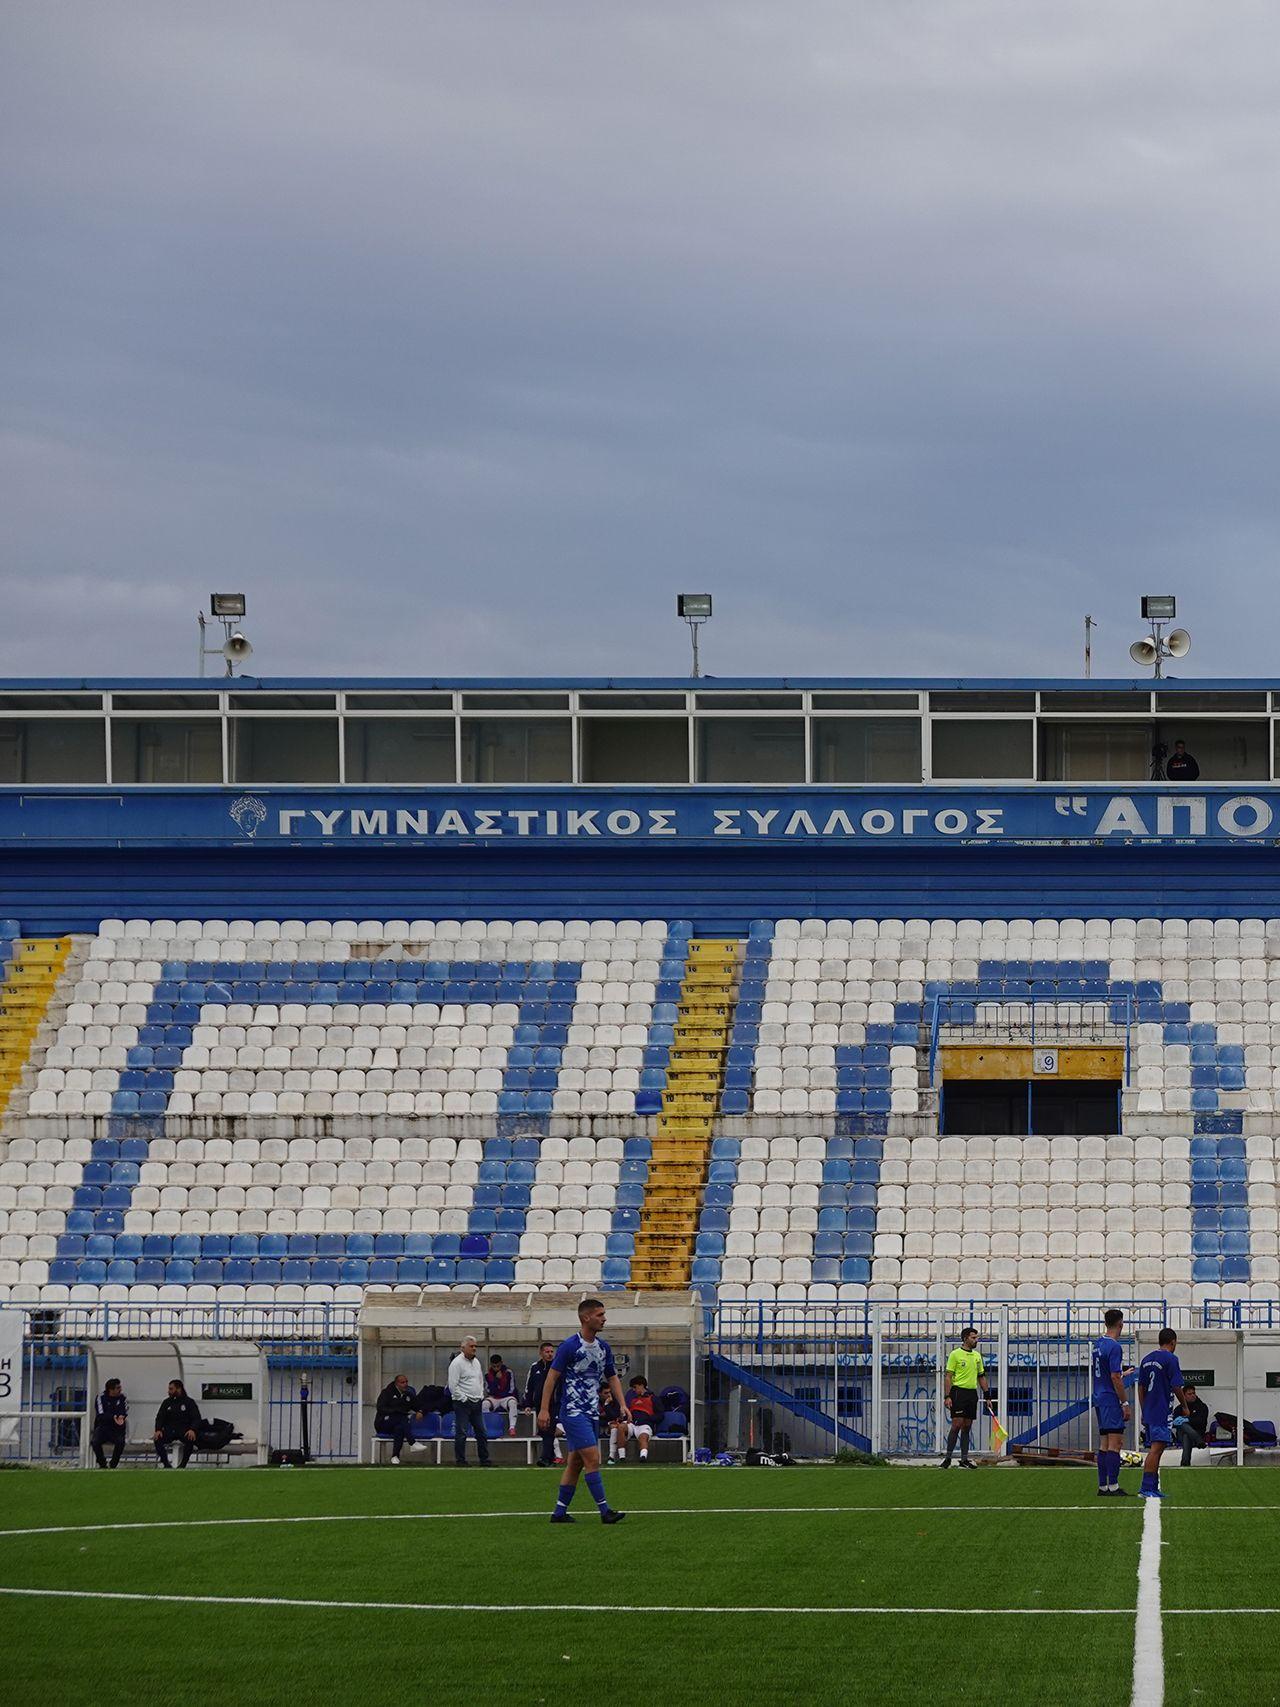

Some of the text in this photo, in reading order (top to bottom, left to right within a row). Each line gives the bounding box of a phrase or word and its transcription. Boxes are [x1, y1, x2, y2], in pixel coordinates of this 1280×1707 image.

[279, 809, 677, 836] ΓΥΜΝΑΣΤΙΚΟΣ
[713, 809, 1005, 836] ΣΥΛΛΟΓΟΣ
[1044, 1055, 1054, 1071] 9
[1147, 1371, 1156, 1392] 3
